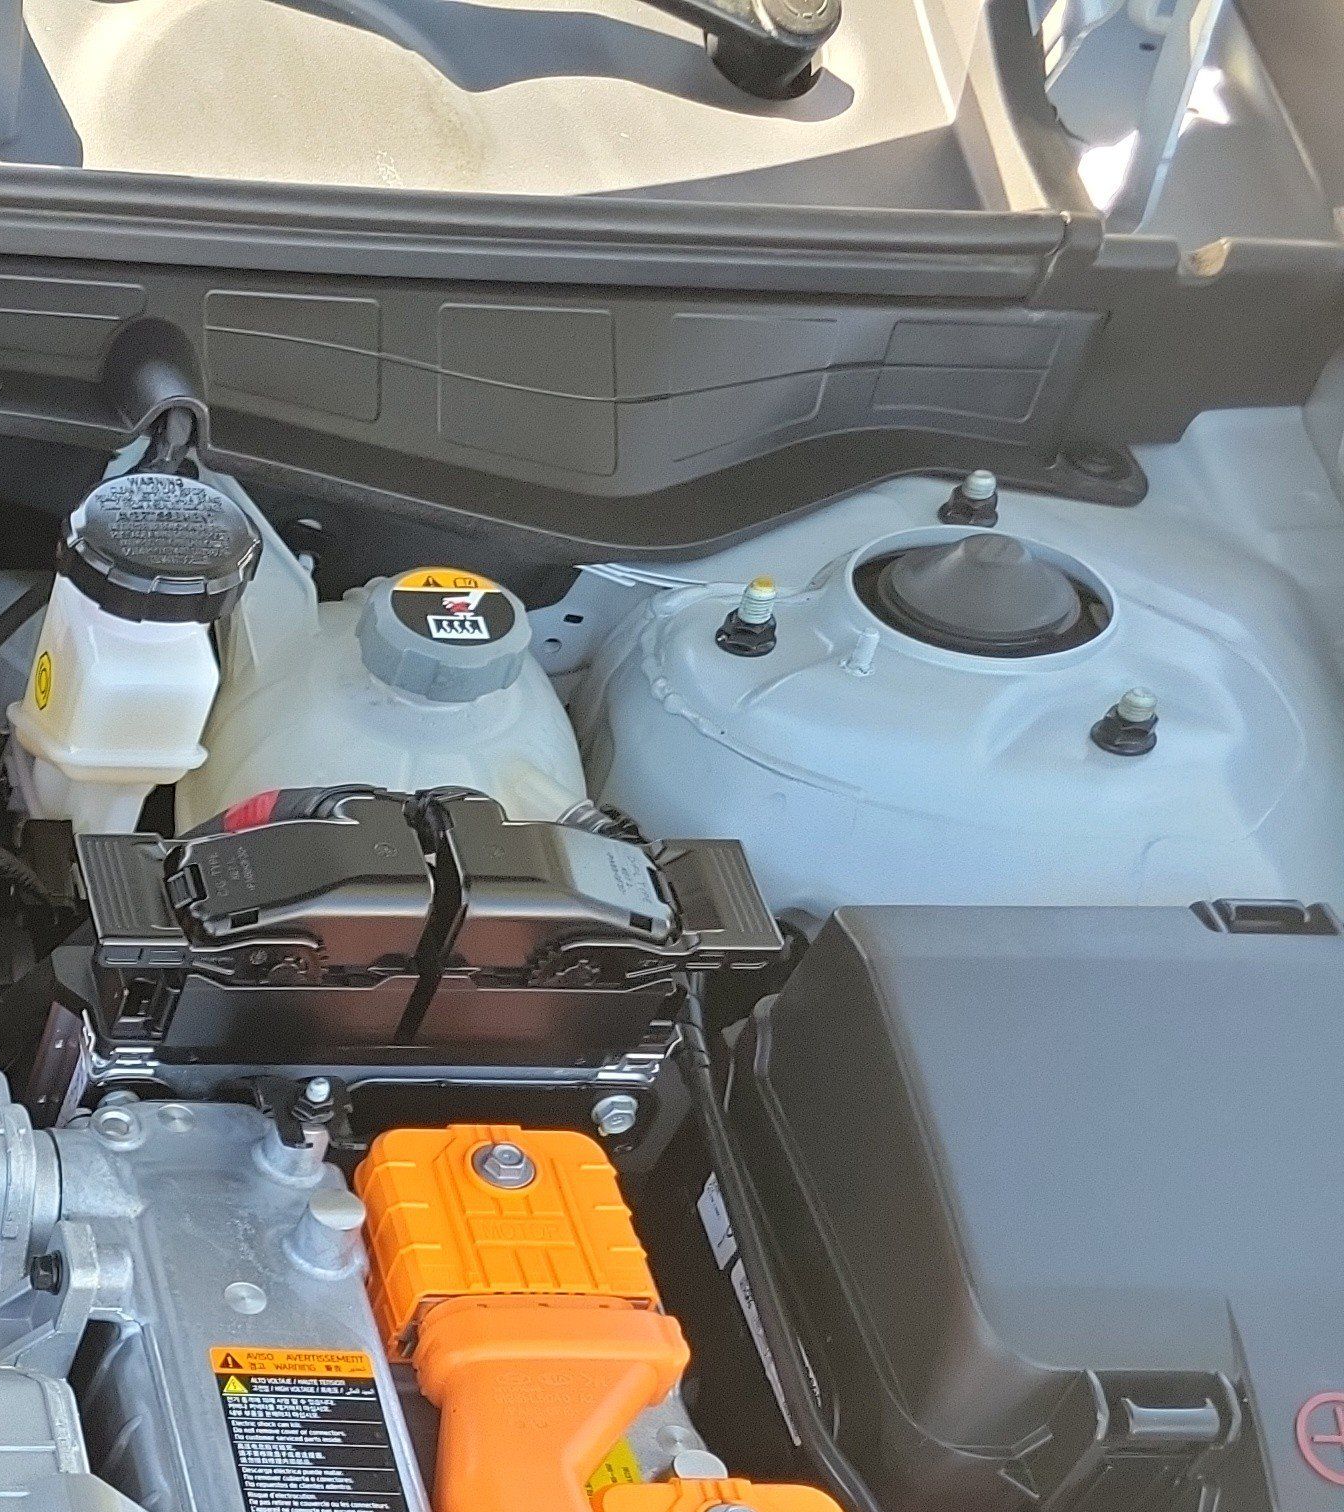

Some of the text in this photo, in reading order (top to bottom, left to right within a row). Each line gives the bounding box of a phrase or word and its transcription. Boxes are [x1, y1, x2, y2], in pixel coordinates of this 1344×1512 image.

[247, 1353, 364, 1364] AVISO AVERTISSEMENT
[274, 1363, 317, 1372] WARNING
